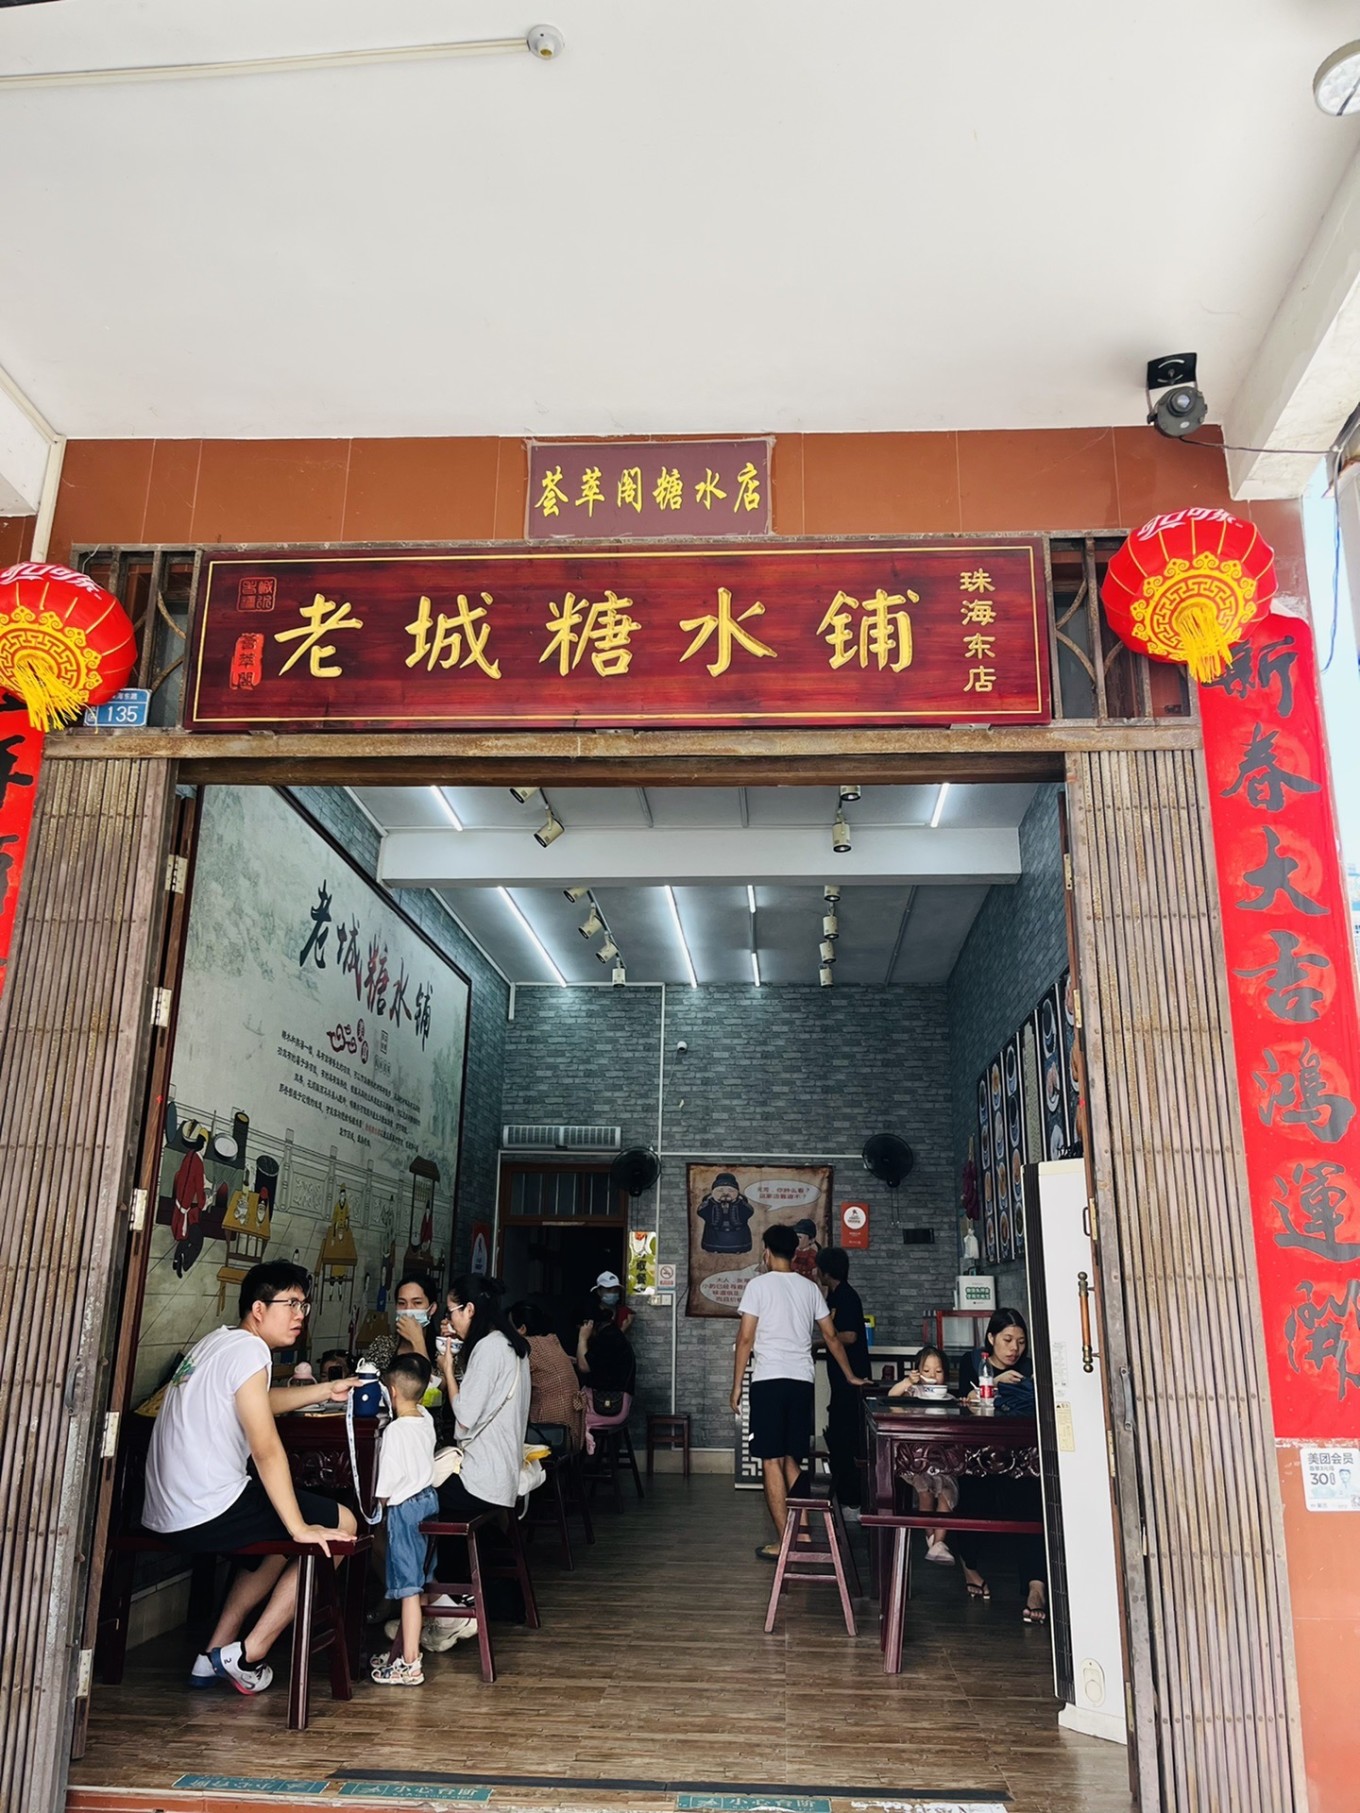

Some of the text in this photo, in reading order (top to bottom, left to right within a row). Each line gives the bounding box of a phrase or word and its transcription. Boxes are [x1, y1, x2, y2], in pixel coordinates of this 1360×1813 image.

[273, 587, 920, 679] 老城糖水铺
[959, 568, 997, 692] 珠海东店
[113, 692, 138, 700] 海东路
[107, 705, 138, 723] 135
[1308, 1452, 1354, 1465] 美团会员
